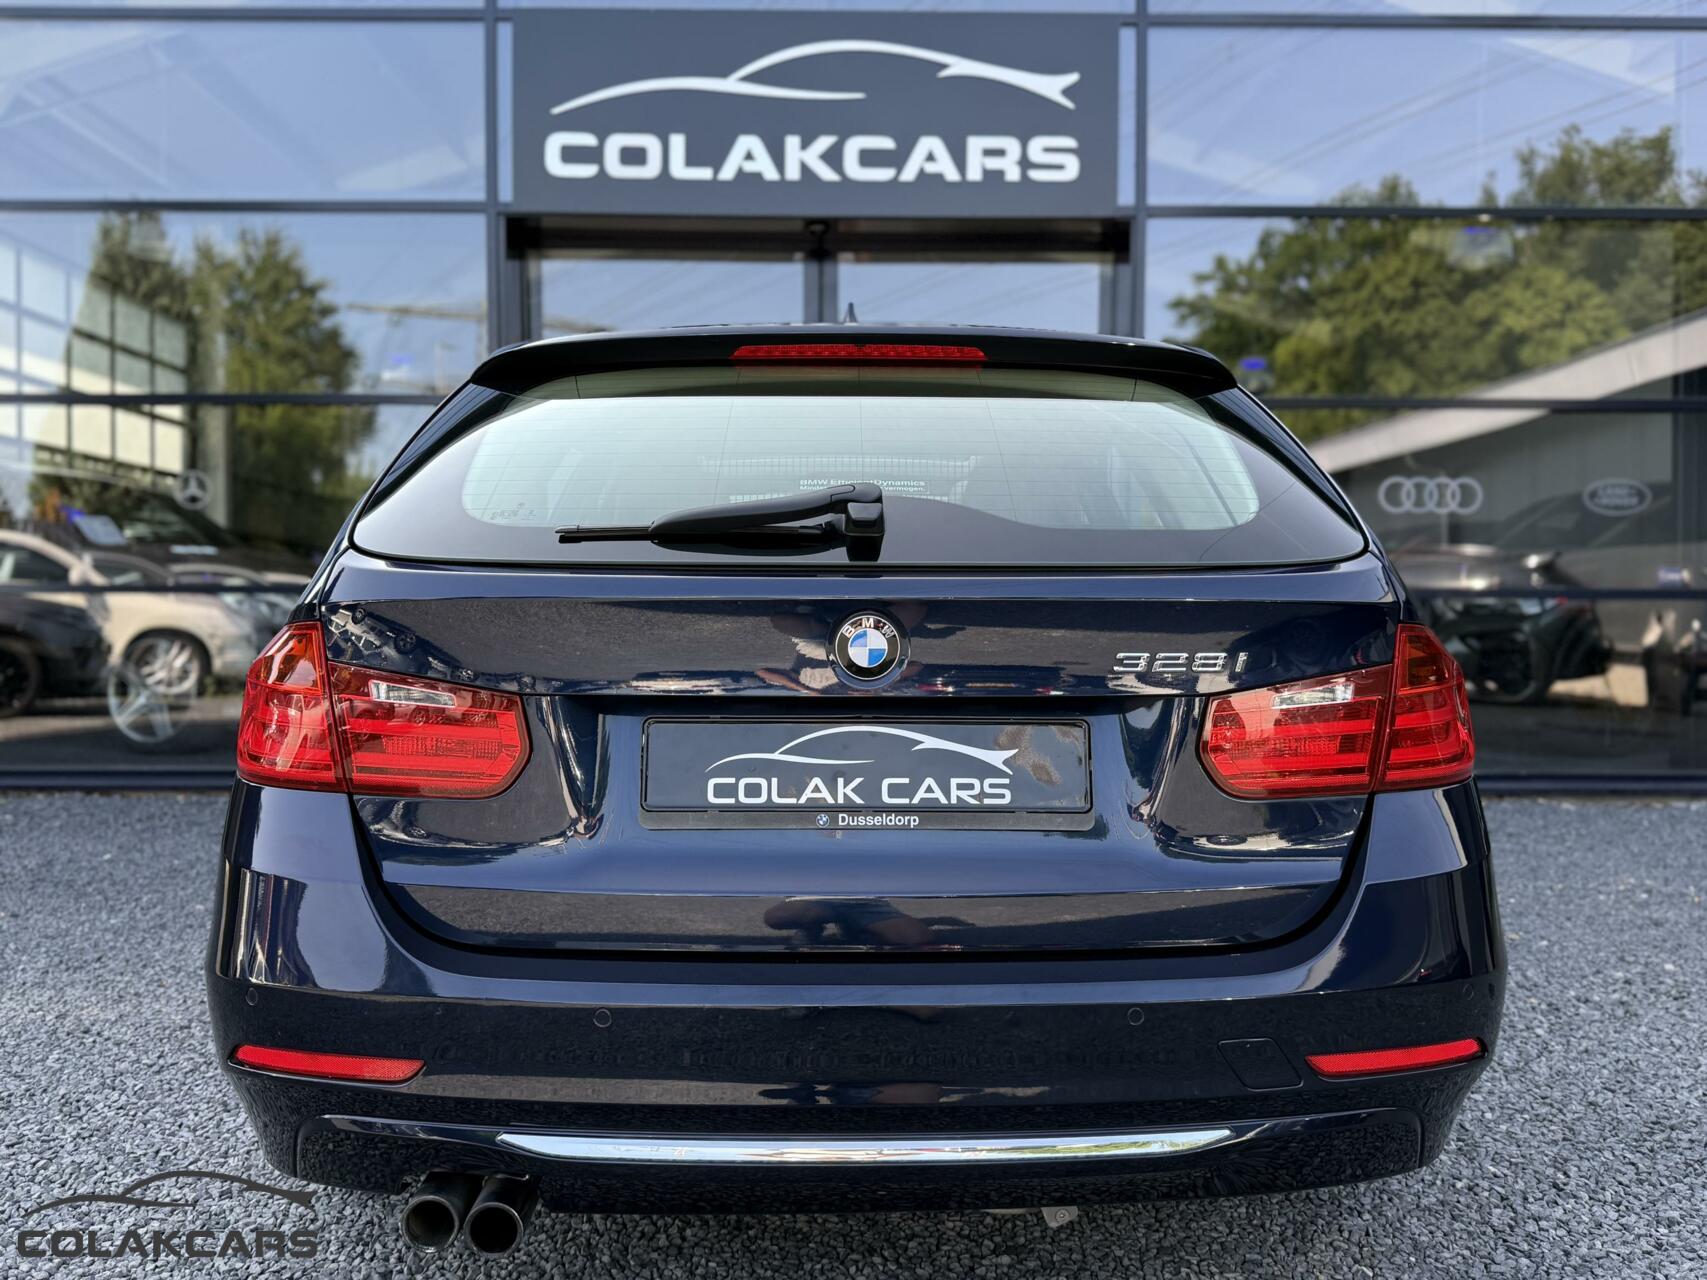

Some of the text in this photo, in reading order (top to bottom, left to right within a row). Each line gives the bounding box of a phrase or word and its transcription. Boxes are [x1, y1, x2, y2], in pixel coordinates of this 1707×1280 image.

[543, 130, 1082, 183] COLAKCARS
[842, 617, 896, 639] BMW
[1113, 652, 1249, 673] 328i
[707, 777, 1012, 804] COLAK CARS
[838, 813, 920, 828] Dusseldorp
